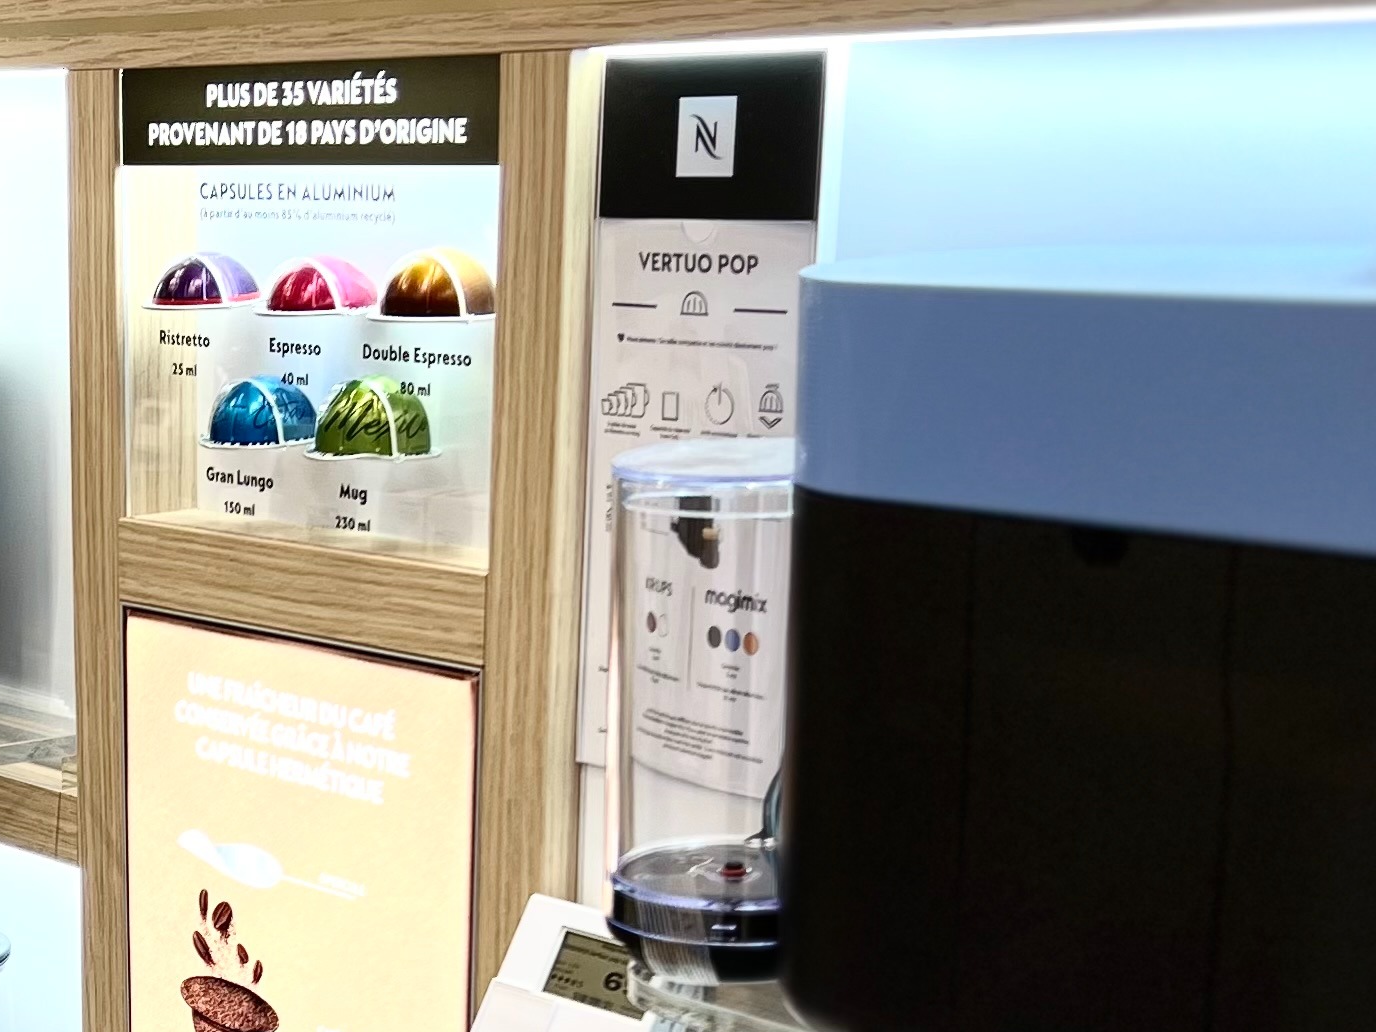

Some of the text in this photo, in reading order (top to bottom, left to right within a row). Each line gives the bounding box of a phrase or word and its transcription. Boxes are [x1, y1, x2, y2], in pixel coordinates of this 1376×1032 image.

[206, 69, 397, 108] PLUS DE 35 VARIÉTÉS
[148, 117, 468, 147] PROVENANT DE 18 PAYS D'ORIGINE
[199, 182, 396, 202] CAPSULES EN ALUMINIUM
[638, 251, 760, 276] VERTUO POP
[159, 329, 211, 349] Ristretto
[269, 337, 322, 360] Espresso
[362, 343, 472, 370] Double Espresso
[172, 363, 198, 377] 25 ml
[280, 372, 309, 387] 40 ml
[399, 381, 431, 397] 80 ml
[206, 466, 274, 492] Gran Lungo
[339, 483, 368, 505] Mug
[223, 501, 256, 517] 150 ml
[335, 515, 371, 532] 230 ml
[704, 589, 768, 614] magimix
